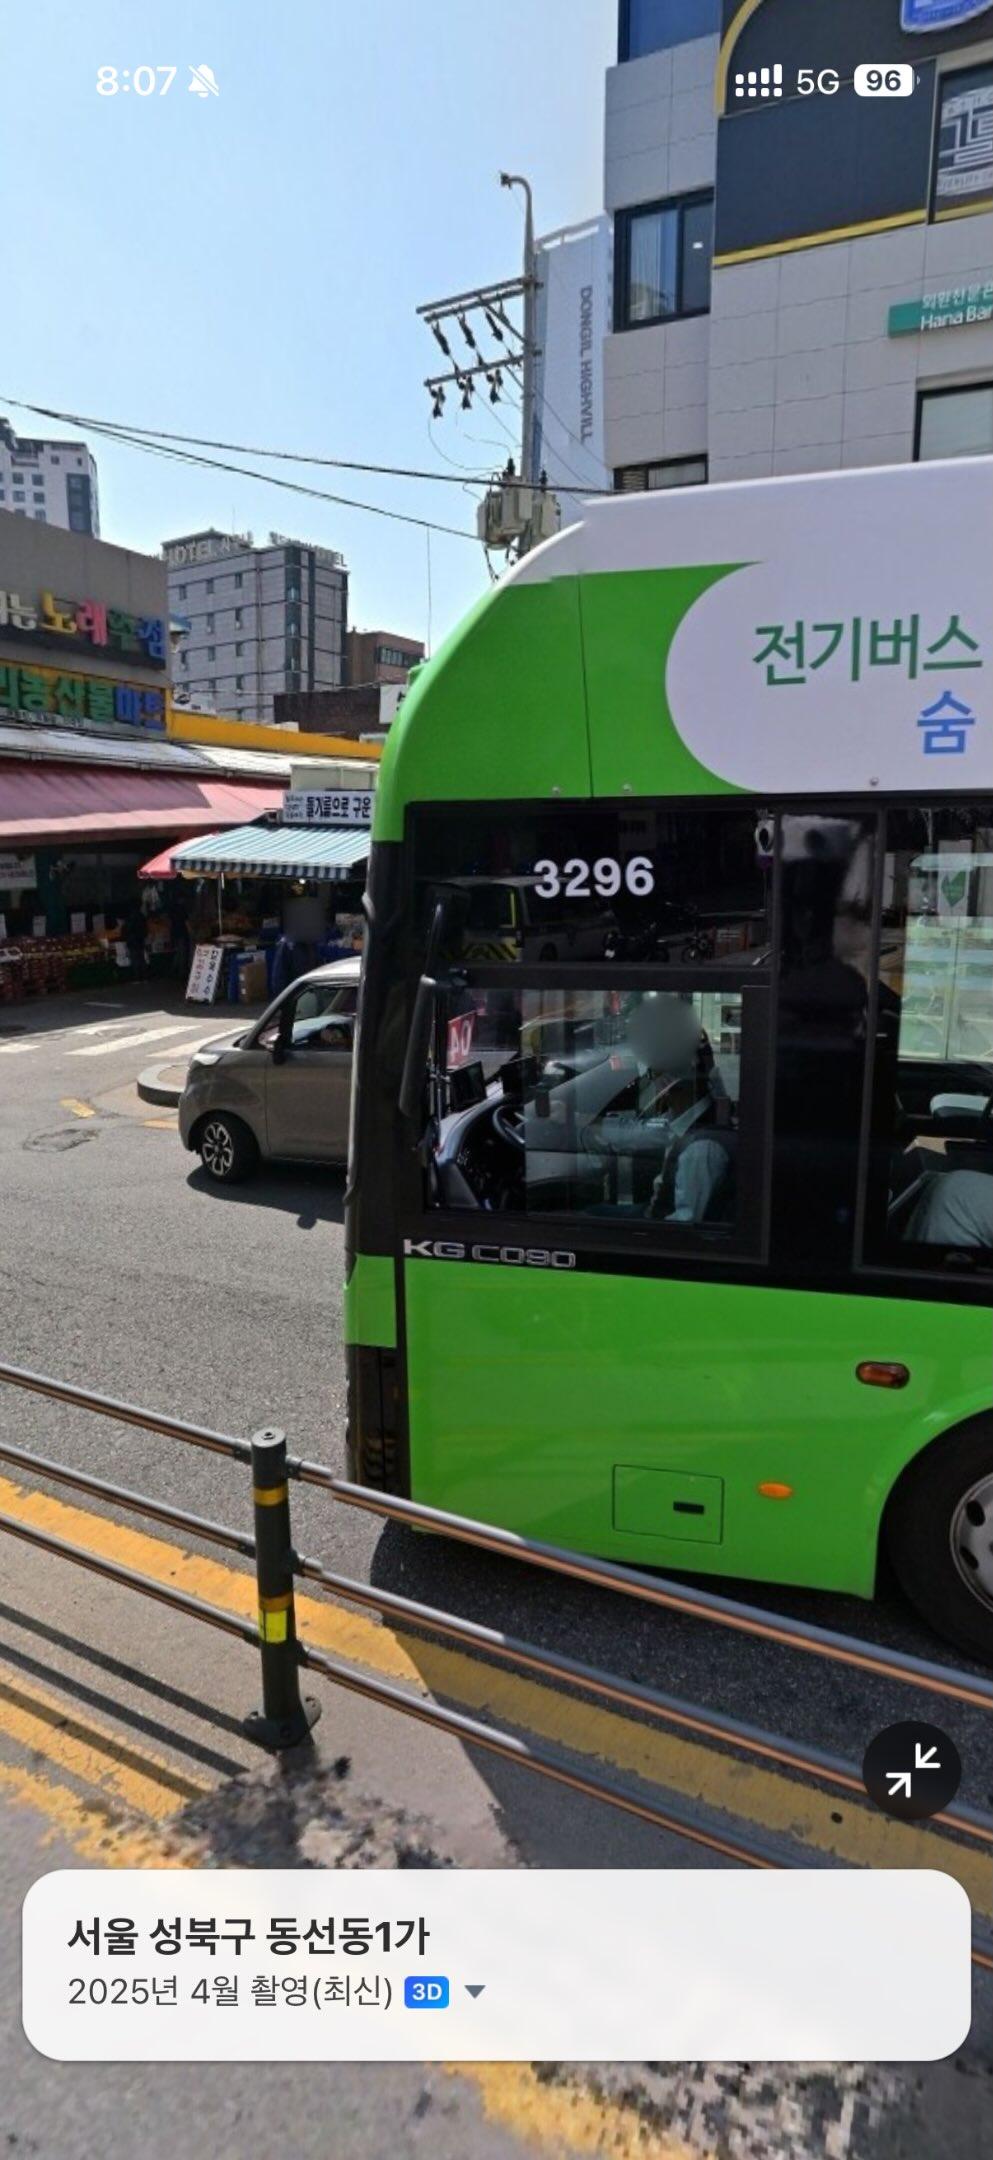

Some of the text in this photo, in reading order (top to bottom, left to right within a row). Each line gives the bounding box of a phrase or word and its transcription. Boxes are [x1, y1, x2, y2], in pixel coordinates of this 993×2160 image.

[921, 311, 963, 331] Hana
[580, 284, 594, 443] DONGIL HIGHVILL
[753, 613, 983, 686] 전기버스
[917, 690, 976, 755] 숨
[306, 796, 349, 817] 들기름으로
[353, 797, 371, 818] 구운
[533, 857, 655, 898] 3296
[403, 1239, 576, 1268] KG C090
